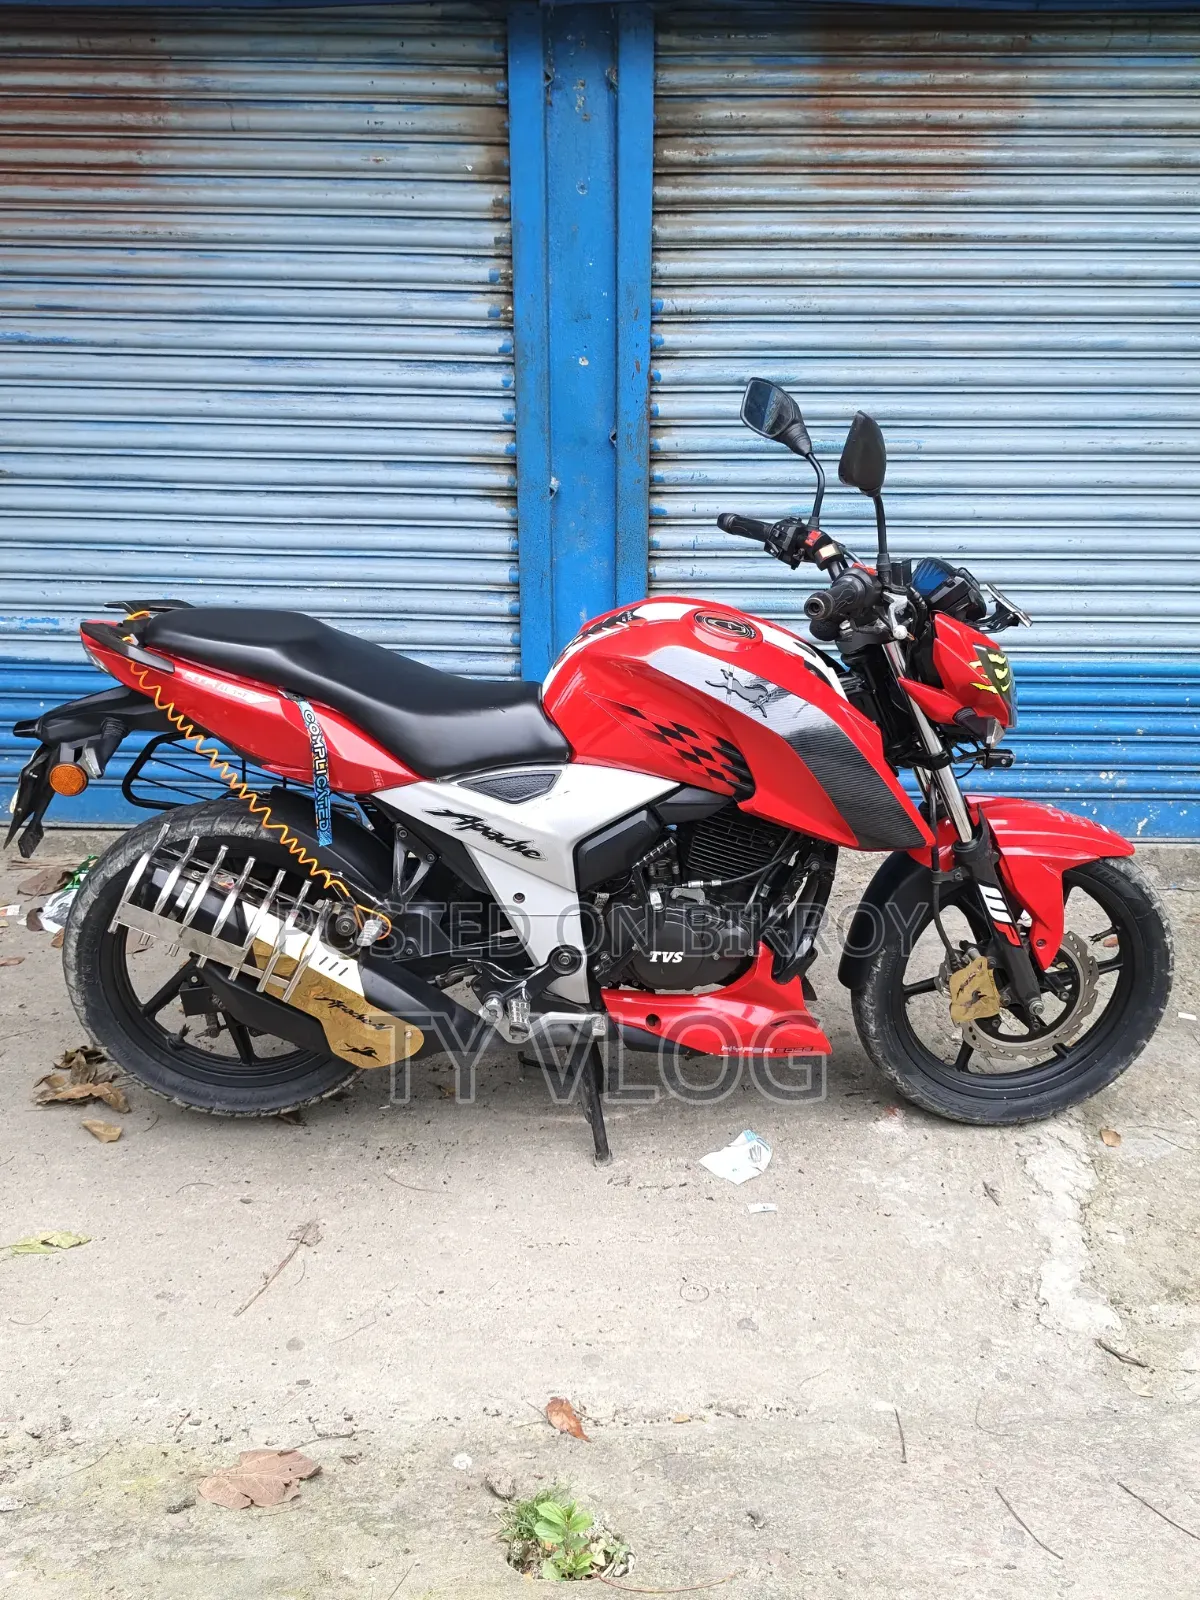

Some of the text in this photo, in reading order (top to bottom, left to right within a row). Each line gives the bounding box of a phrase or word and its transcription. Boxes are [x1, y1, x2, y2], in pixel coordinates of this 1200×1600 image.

[303, 709, 331, 831] COMPLICATED
[423, 809, 546, 861] Apache
[649, 950, 685, 964] TVS
